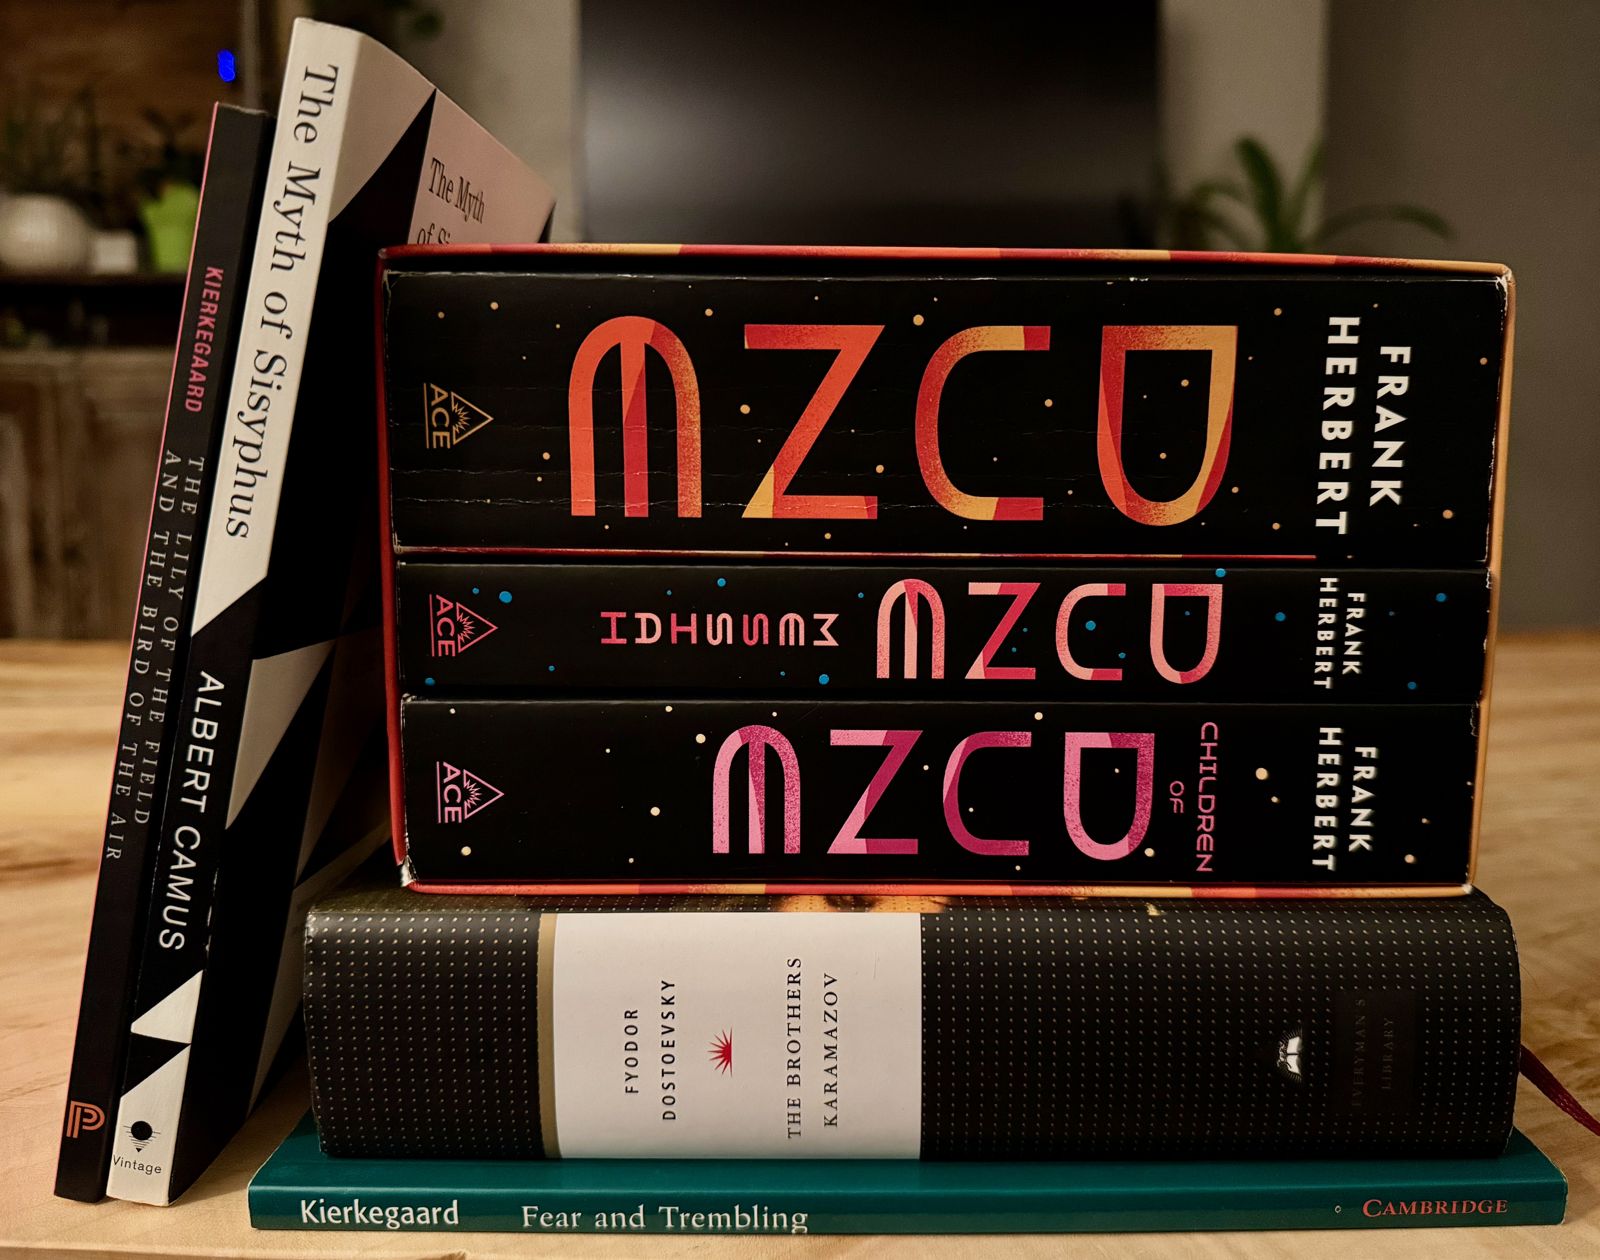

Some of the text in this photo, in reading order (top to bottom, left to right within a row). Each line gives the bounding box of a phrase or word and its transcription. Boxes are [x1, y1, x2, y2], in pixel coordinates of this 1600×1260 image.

[417, 222, 435, 244] of
[428, 157, 485, 224] The Myth
[184, 266, 224, 413] KIERKEGAARD
[225, 64, 339, 539] The Myth of Sisyphus
[430, 384, 451, 449] ACE
[1316, 317, 1360, 534] HERBERT
[1370, 347, 1411, 506] FRANK
[106, 449, 182, 859] AND THE BIRD OF THE AIR
[134, 456, 205, 824] THE LILY OF THE FIELD
[435, 594, 456, 657] ACE
[1313, 577, 1339, 689] HERBERT
[1343, 593, 1365, 674] FRANK
[158, 670, 225, 950] ALBERT CAMUS
[441, 761, 463, 824] ACE
[1170, 781, 1184, 813] OF
[1196, 722, 1218, 871] CHILDREN
[1312, 728, 1342, 870] HERBERT
[1349, 746, 1378, 852] FRANK
[624, 1009, 639, 1094] FYODOR
[661, 980, 677, 1121] DOSTOEVSKY
[786, 957, 802, 1139] THE BROTHERS
[823, 973, 838, 1127] KARAMAZOV
[112, 1154, 162, 1176] Vintage
[300, 1198, 459, 1228] Kierkegaard
[522, 1205, 809, 1234] Fear and Trembling
